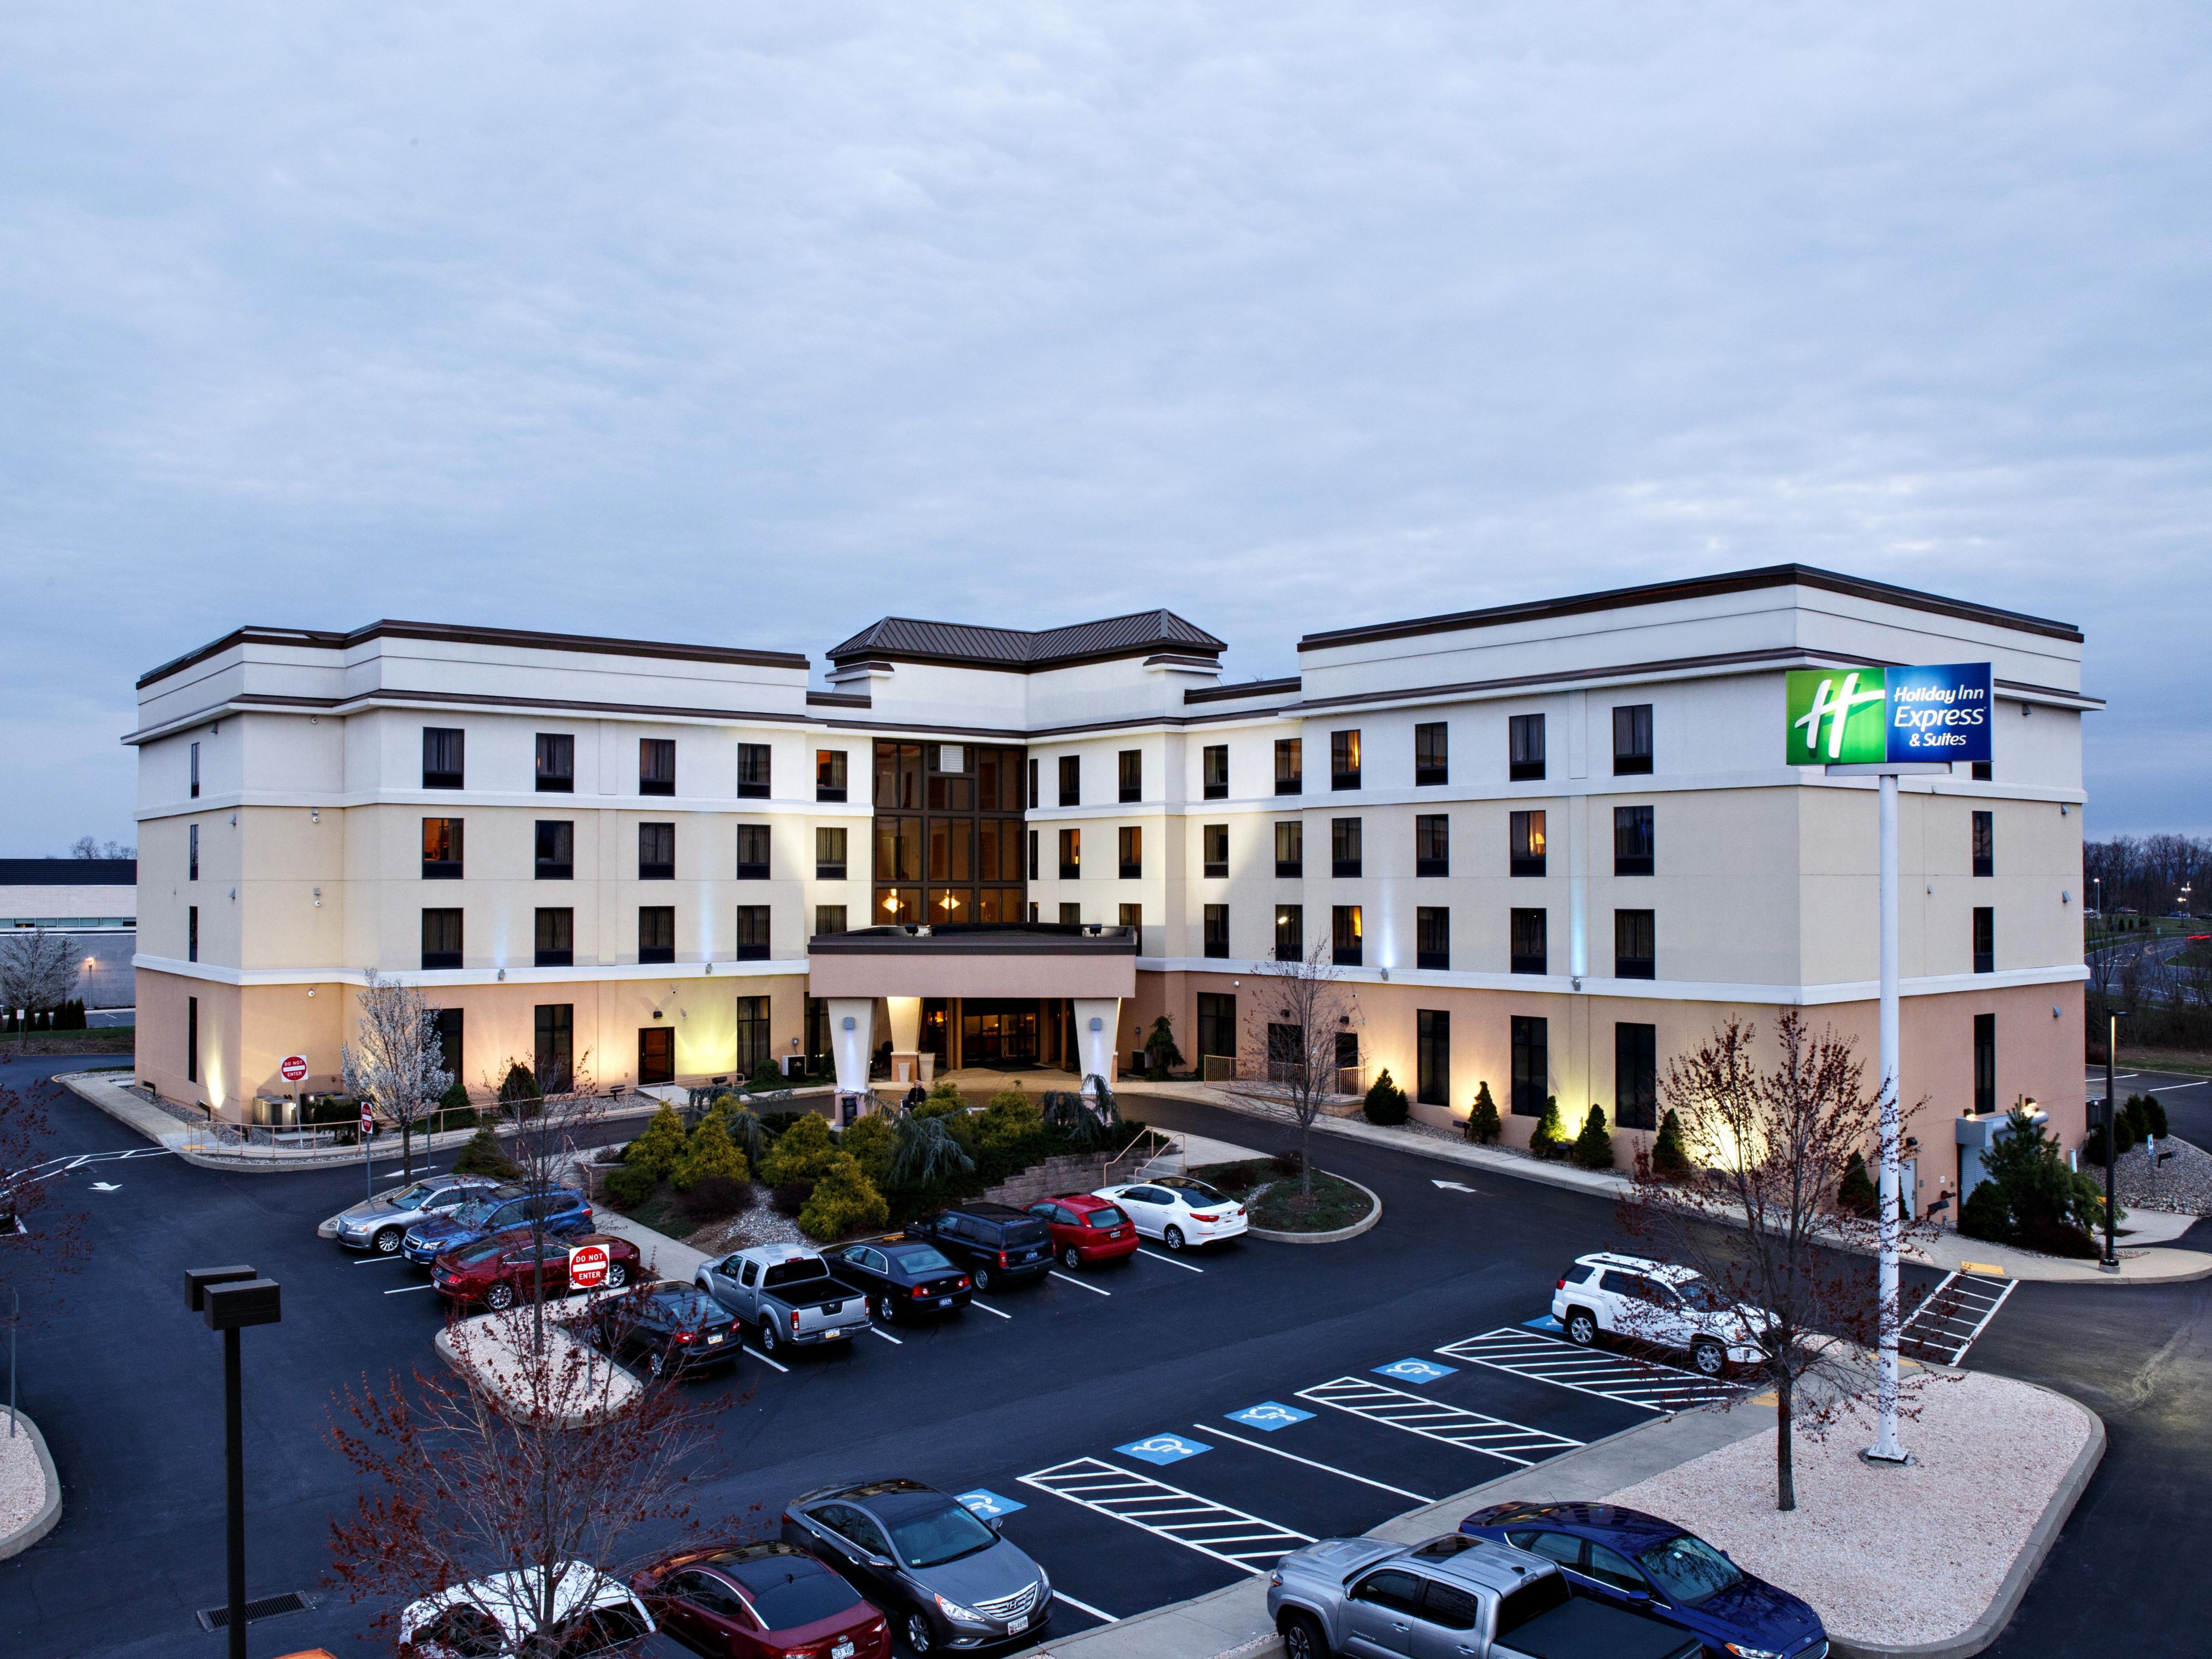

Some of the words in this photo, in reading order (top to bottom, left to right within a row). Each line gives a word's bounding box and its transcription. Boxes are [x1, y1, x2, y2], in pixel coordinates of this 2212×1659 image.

[1893, 686, 1957, 704] Holiday
[1958, 684, 1984, 700] Inn
[1894, 706, 1985, 732] Express
[1909, 733, 1921, 747] &
[1922, 732, 1966, 747] Suites
[588, 1253, 603, 1261] NOT
[578, 1271, 601, 1280] ENTER
[832, 1649, 842, 1658] 923
[844, 1645, 854, 1654] VUR
